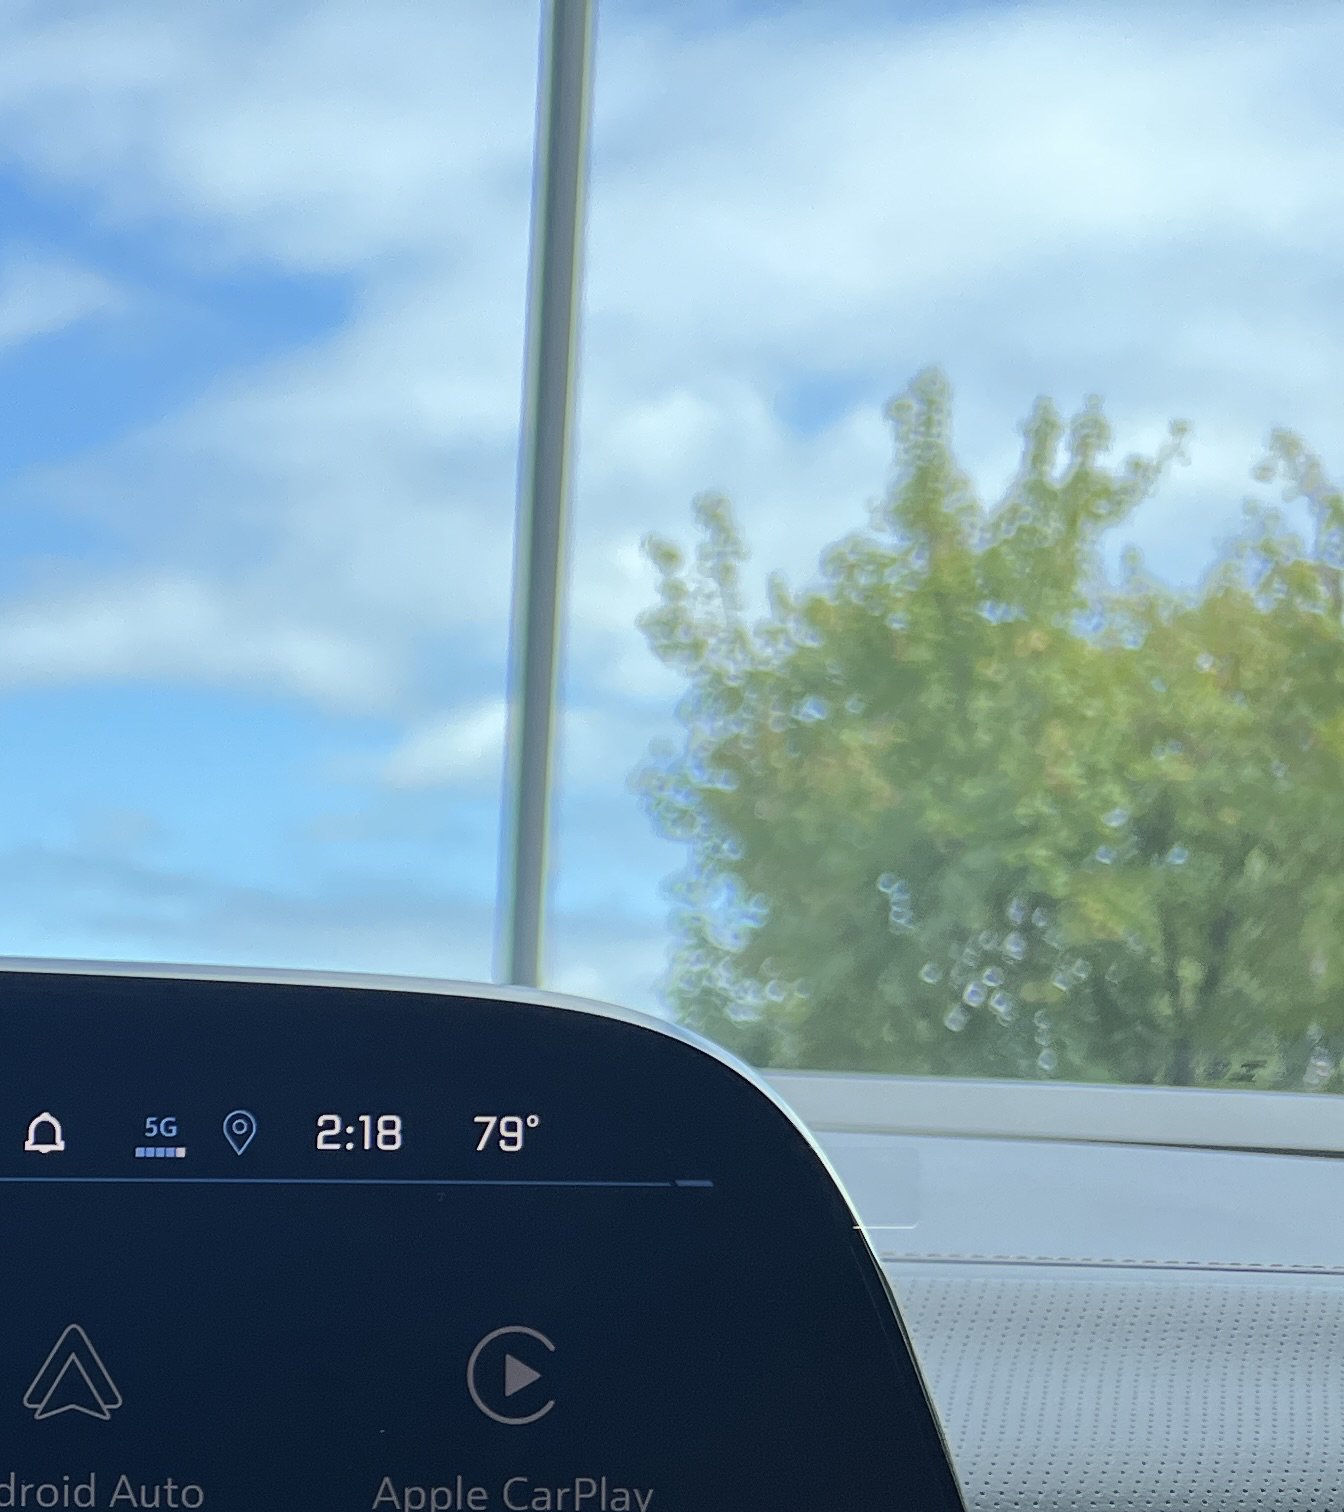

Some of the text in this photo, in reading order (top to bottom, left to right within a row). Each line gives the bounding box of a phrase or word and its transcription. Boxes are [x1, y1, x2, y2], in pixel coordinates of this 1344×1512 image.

[144, 1116, 178, 1137] 5G
[316, 1114, 402, 1151] 2:18
[473, 1114, 540, 1152] 79°
[110, 1474, 204, 1509] Auto
